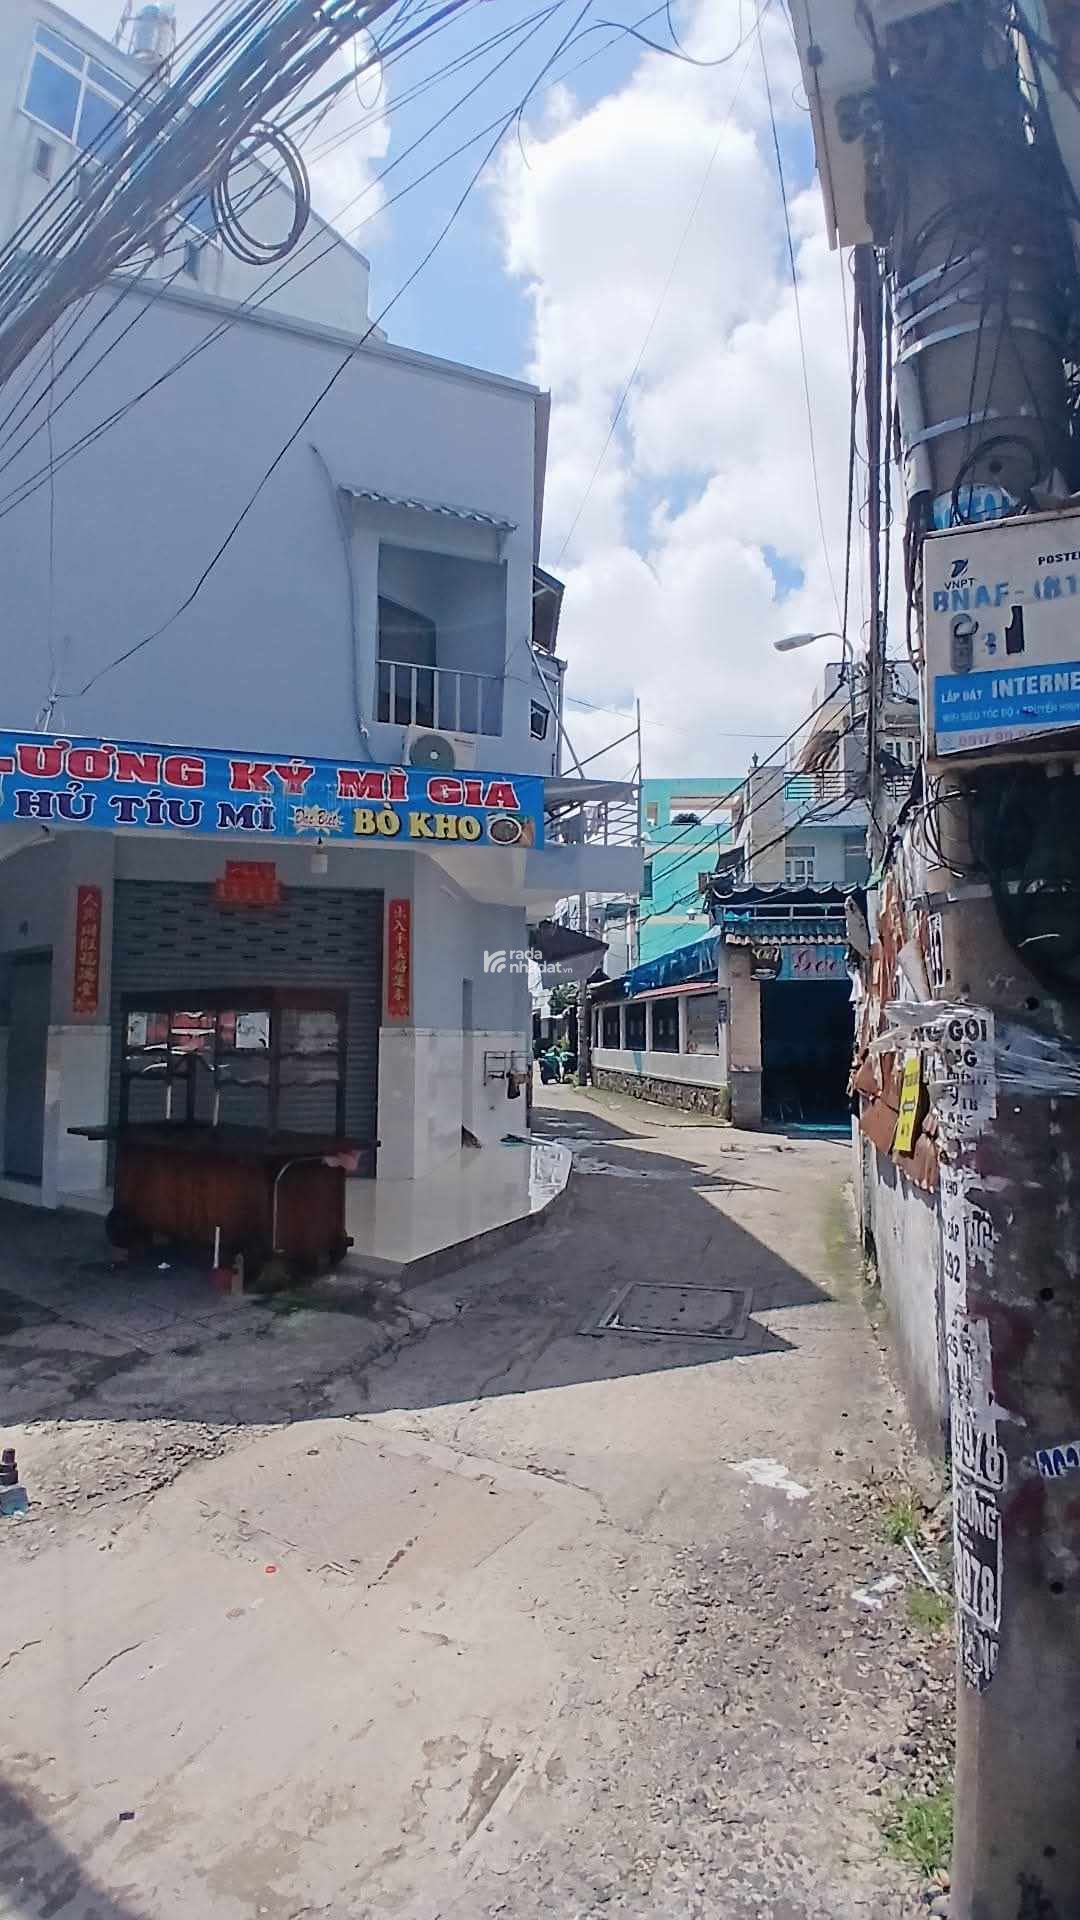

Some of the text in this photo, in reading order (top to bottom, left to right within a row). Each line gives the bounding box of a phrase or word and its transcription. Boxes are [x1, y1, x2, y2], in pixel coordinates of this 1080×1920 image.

[1038, 551, 1080, 566] POSTE
[944, 577, 976, 591] VNPT
[337, 766, 409, 802] MÌ
[426, 777, 521, 810] GIA
[13, 781, 97, 821] HỦ
[108, 791, 203, 828] TÍU
[217, 797, 277, 832] MÌ
[352, 802, 402, 837] BÒ
[408, 811, 482, 842] KHO
